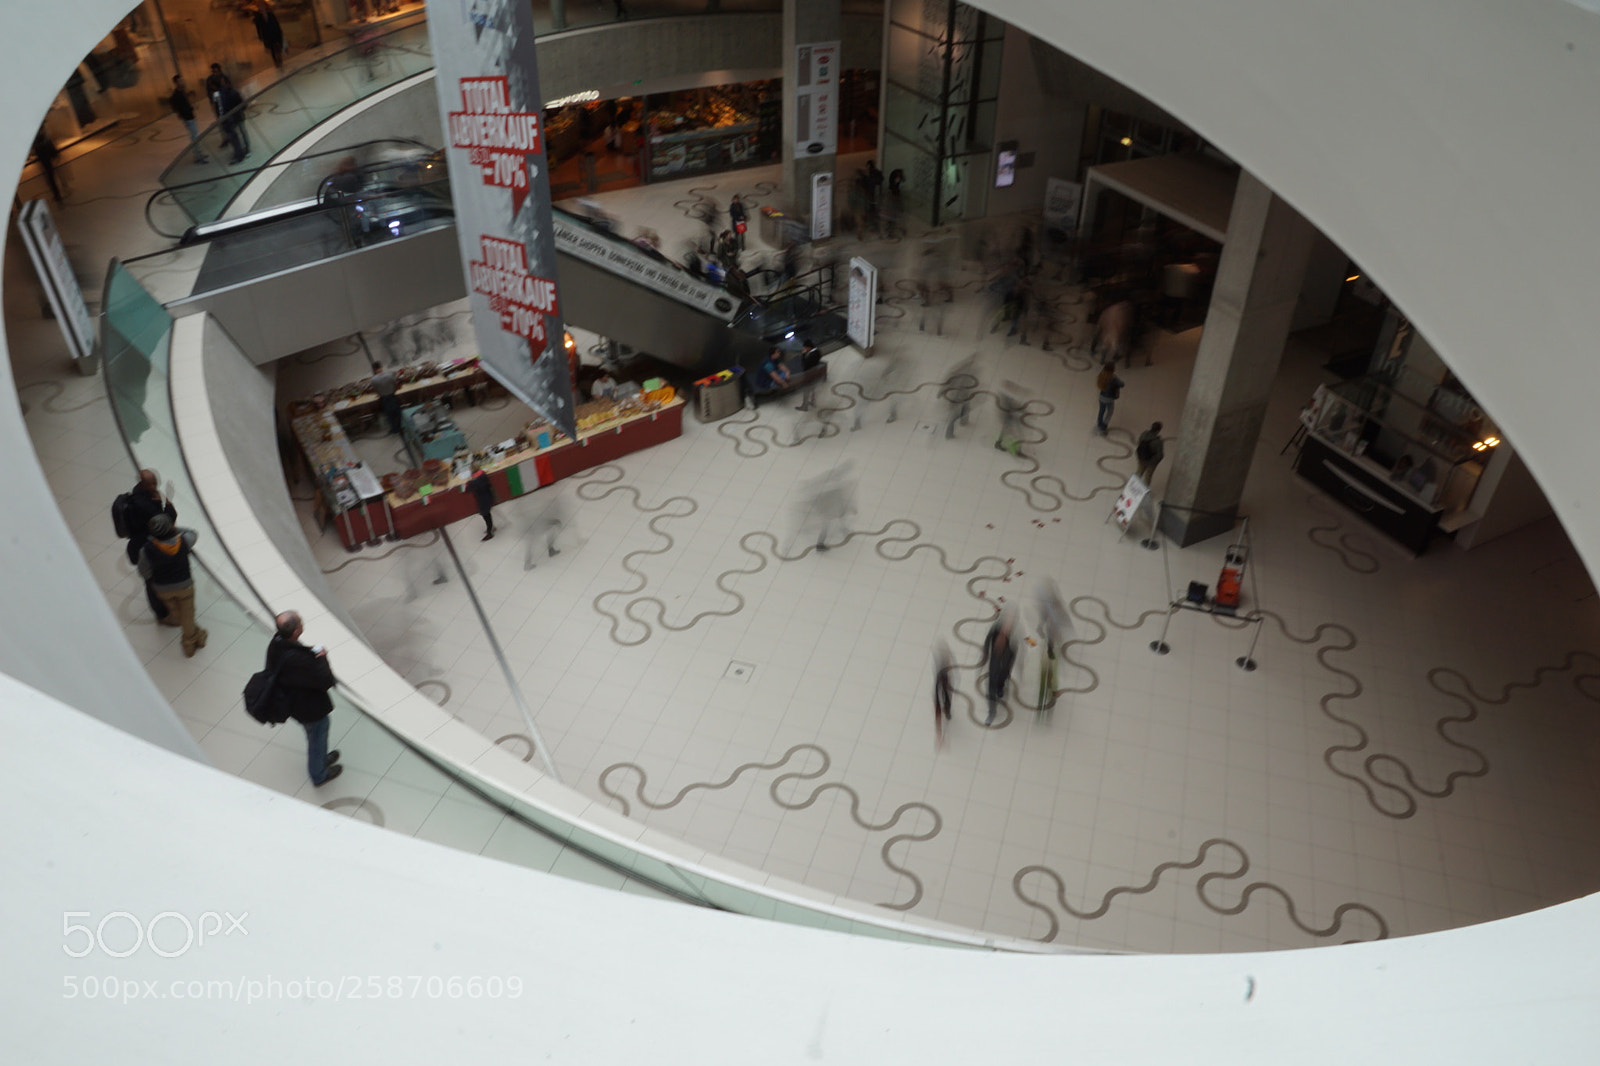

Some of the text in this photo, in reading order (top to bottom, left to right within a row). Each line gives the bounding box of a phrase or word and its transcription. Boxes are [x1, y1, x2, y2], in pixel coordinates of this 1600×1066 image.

[460, 80, 511, 114] TOTAL
[450, 115, 538, 150] ABVERKAUF
[482, 153, 526, 188] -70%
[482, 239, 529, 275] TOTAL
[471, 264, 556, 312] ABVERKAUF
[501, 305, 544, 341] -70%
